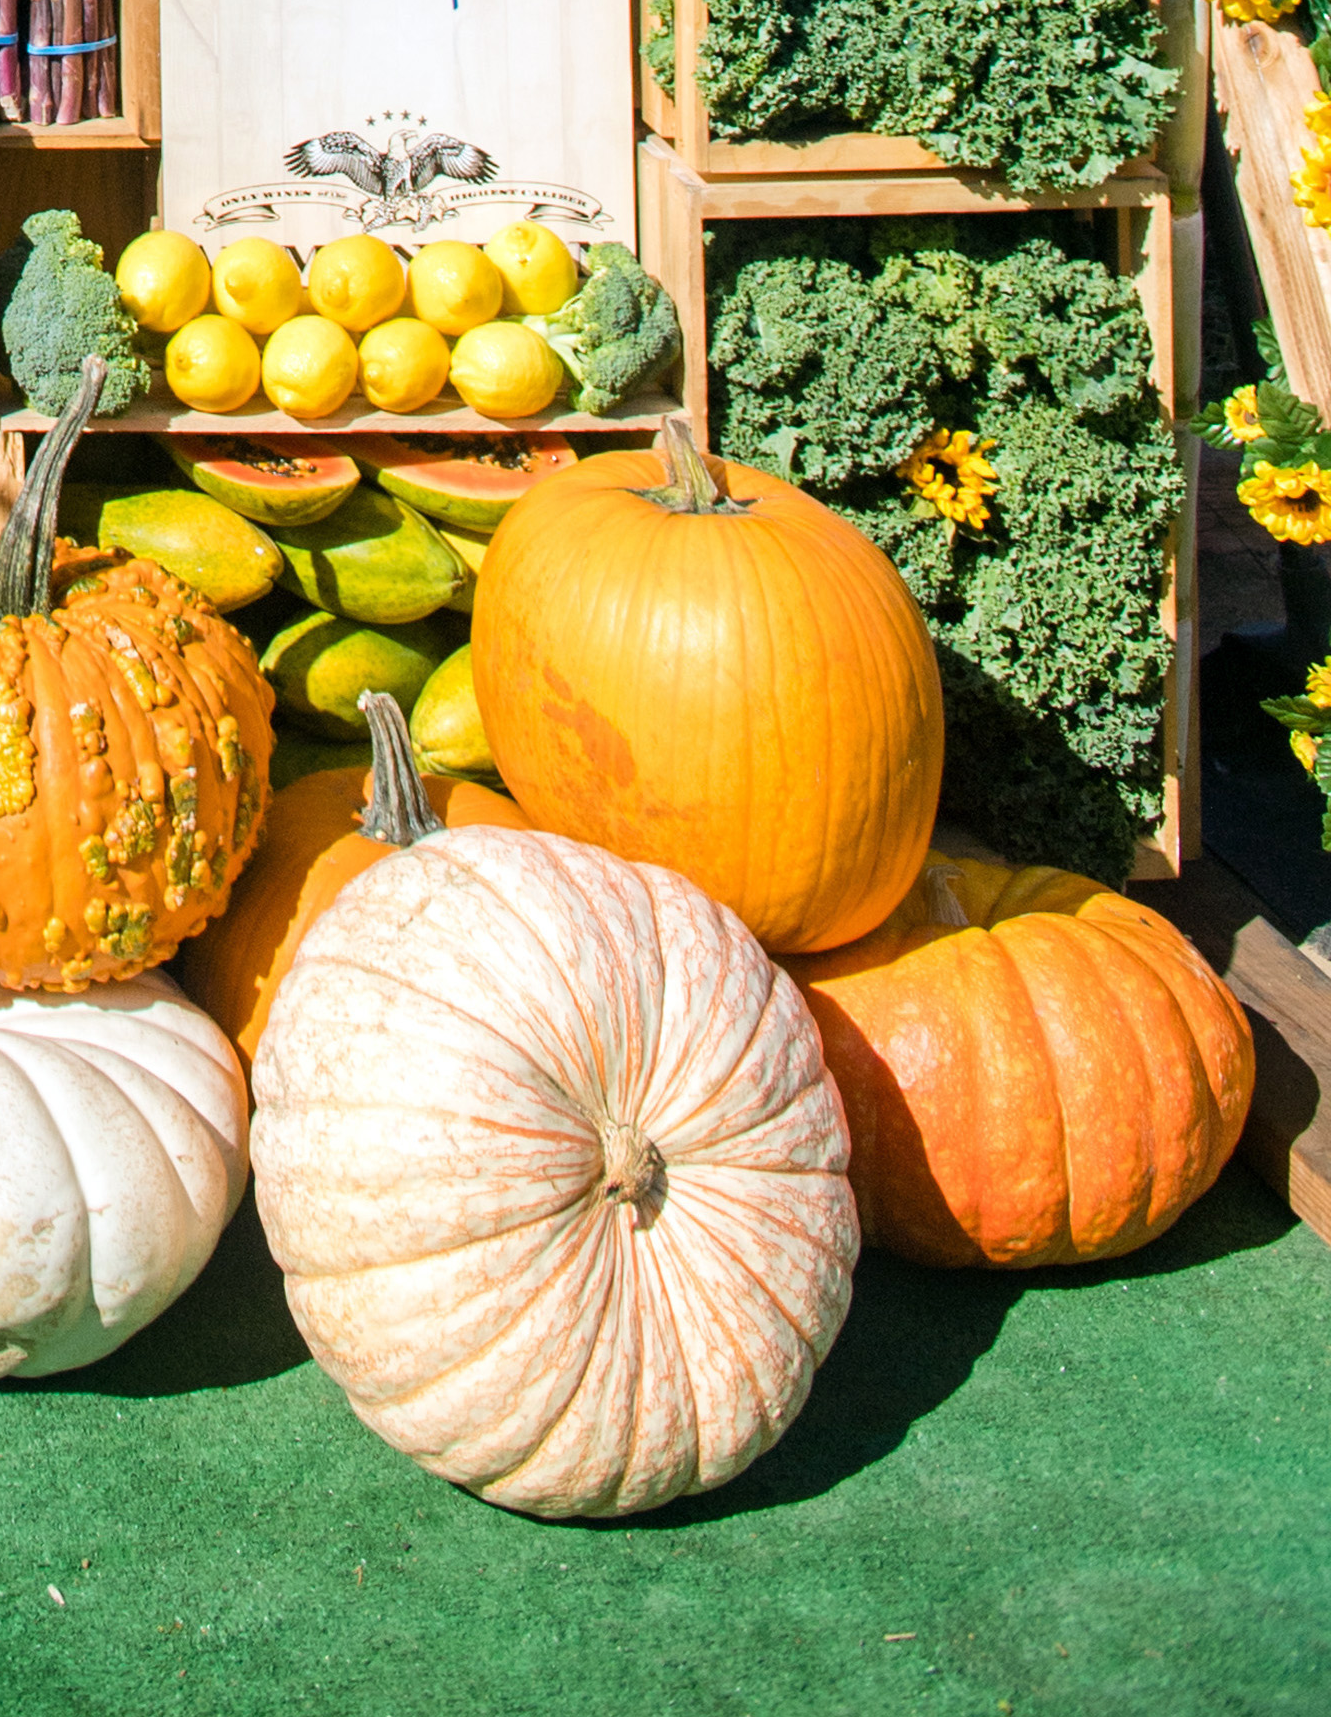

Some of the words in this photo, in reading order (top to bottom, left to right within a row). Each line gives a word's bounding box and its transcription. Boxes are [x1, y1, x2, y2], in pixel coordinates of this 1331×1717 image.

[220, 193, 259, 207] ONLY
[262, 190, 312, 201] WINES
[450, 189, 518, 203] HIGHEST
[521, 189, 589, 207] CALIBER
